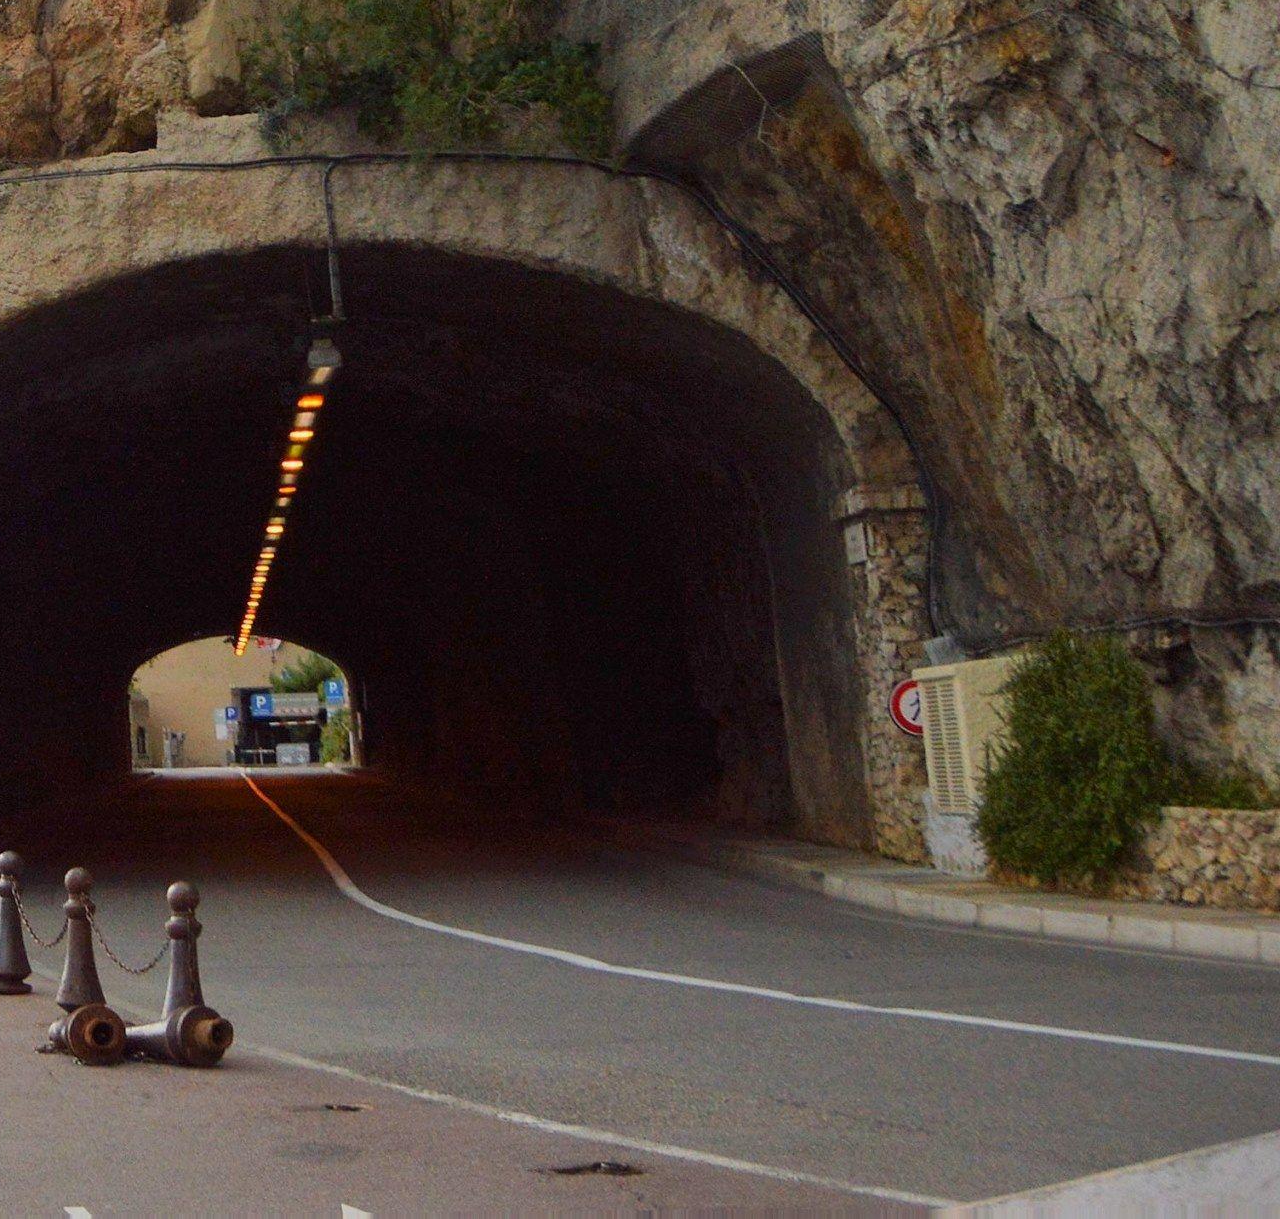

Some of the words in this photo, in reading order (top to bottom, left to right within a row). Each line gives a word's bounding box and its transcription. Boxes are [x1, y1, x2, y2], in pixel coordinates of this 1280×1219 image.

[329, 681, 338, 693] P
[256, 695, 267, 708] P
[227, 707, 236, 718] P
